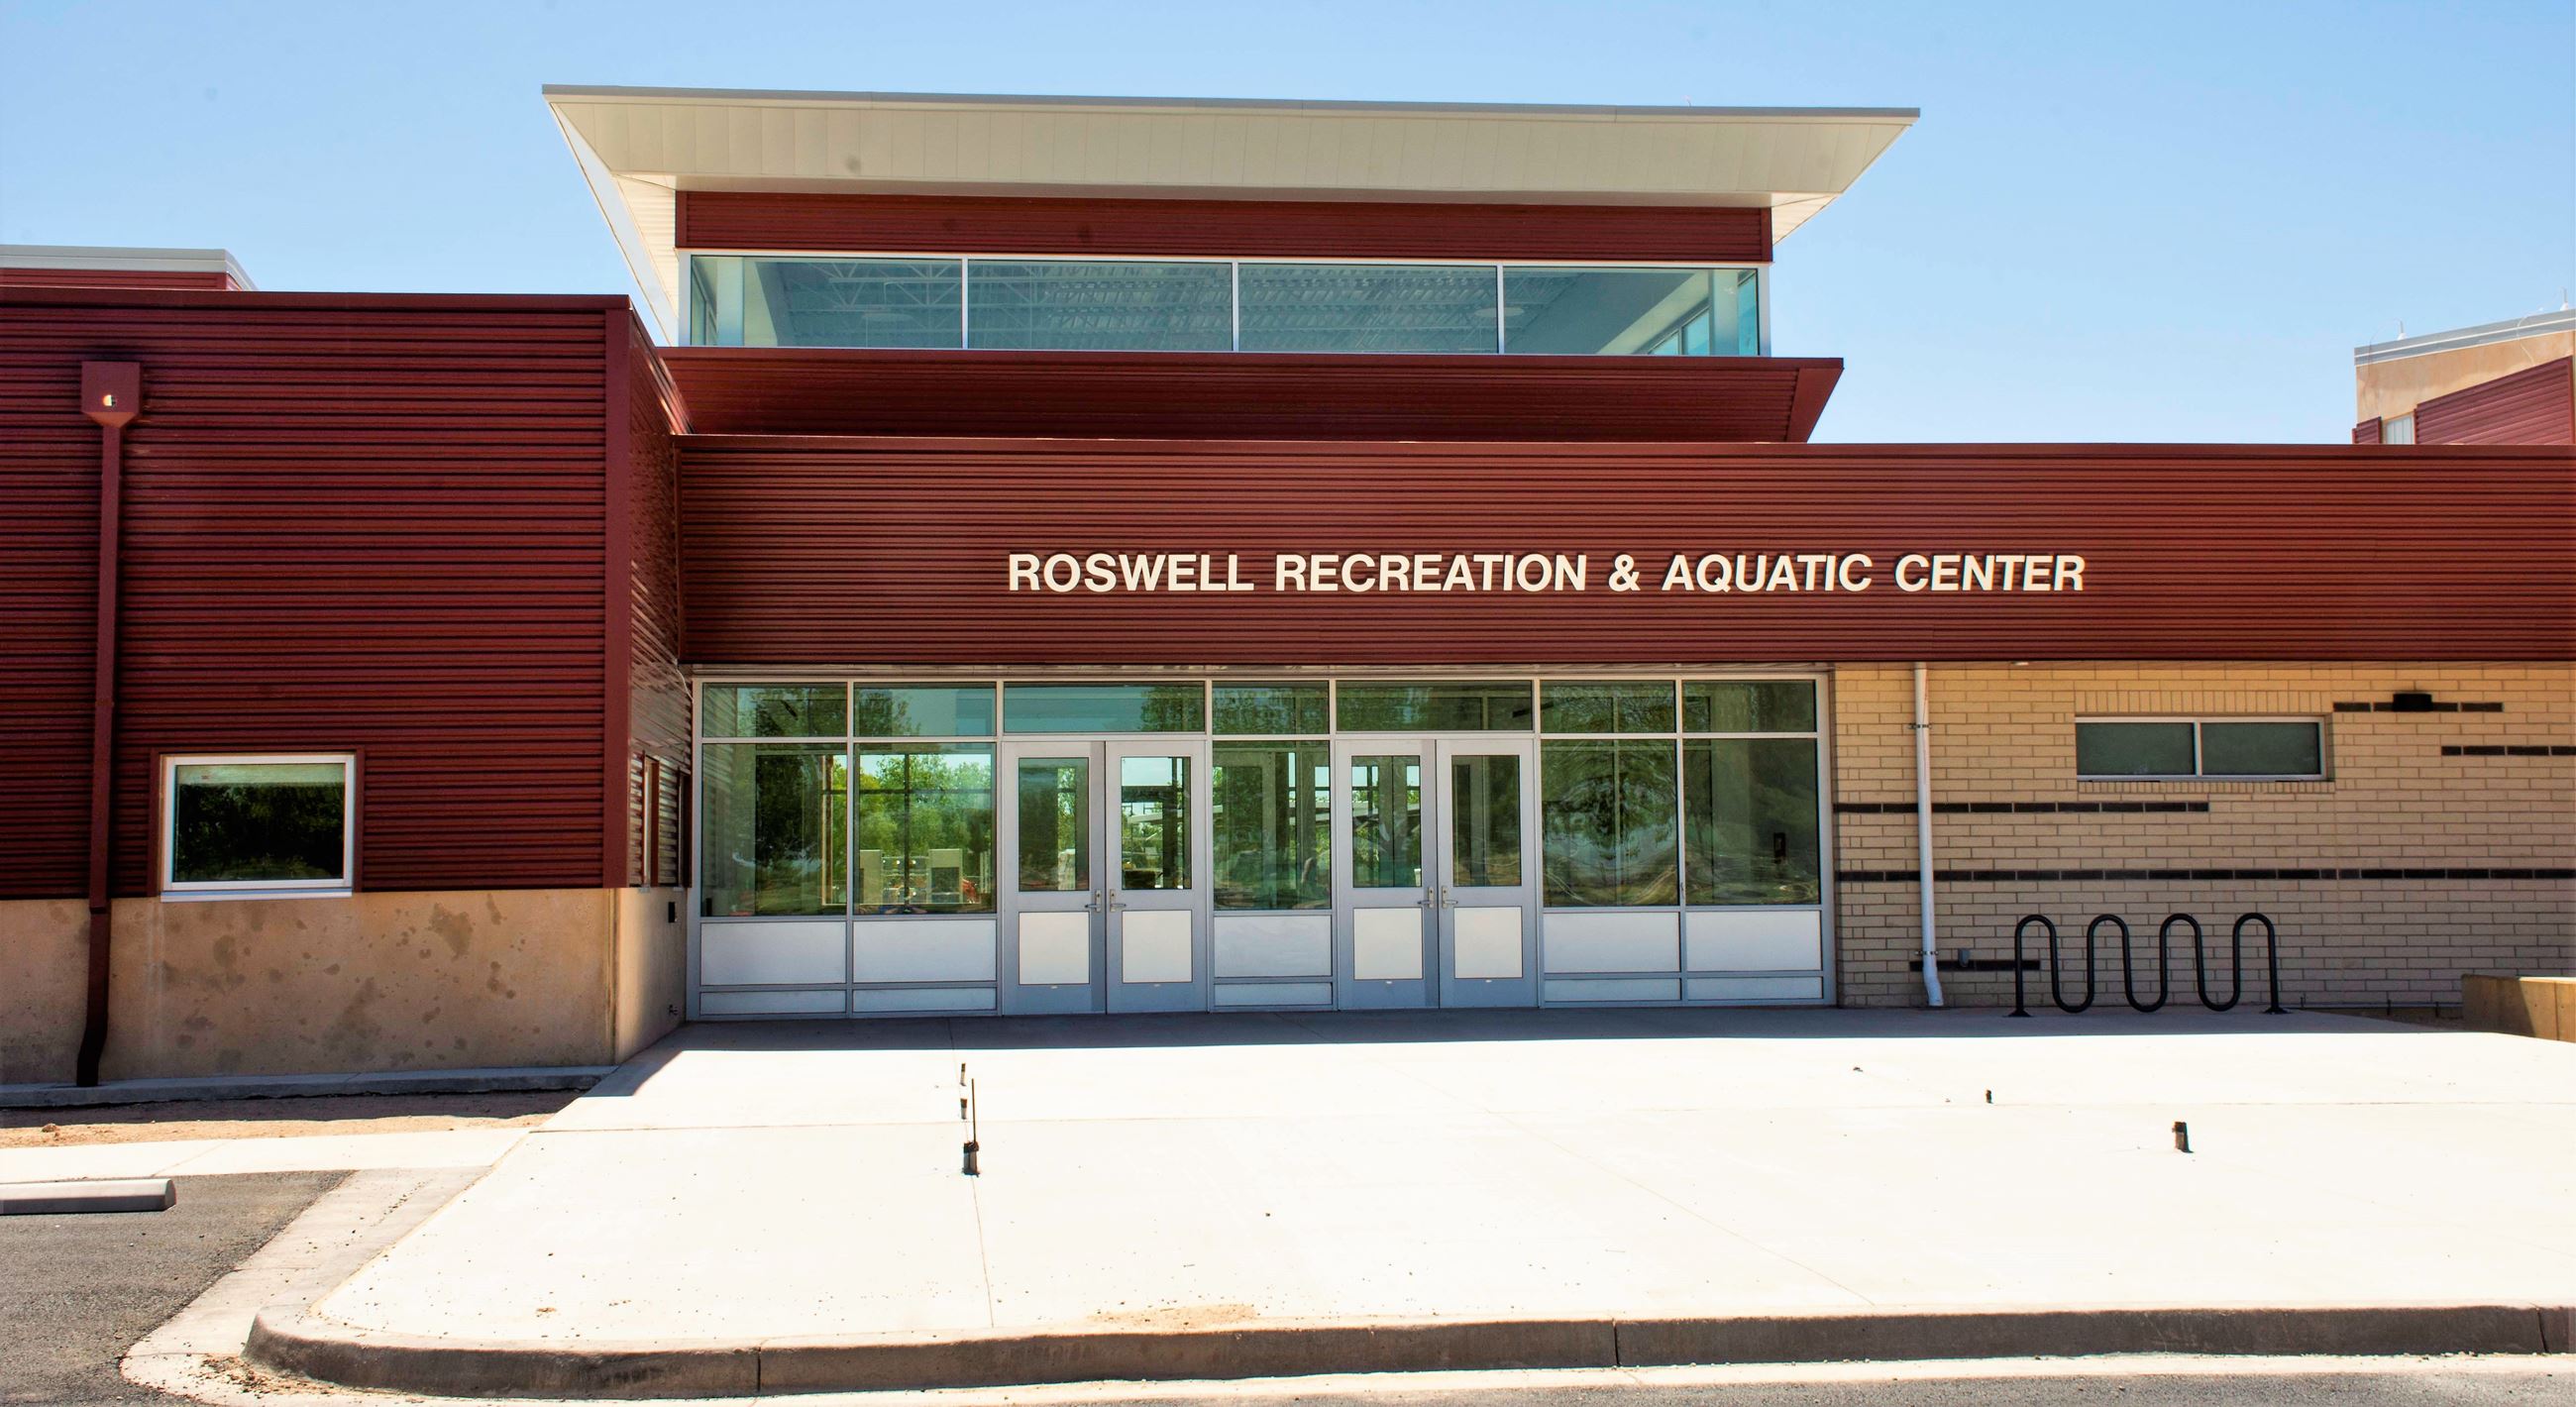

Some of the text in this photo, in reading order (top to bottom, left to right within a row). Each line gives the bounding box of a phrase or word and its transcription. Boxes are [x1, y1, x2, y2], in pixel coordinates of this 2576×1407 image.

[1009, 553, 2086, 594] ROSWELL RECREATION & AQUATIC CENTER
